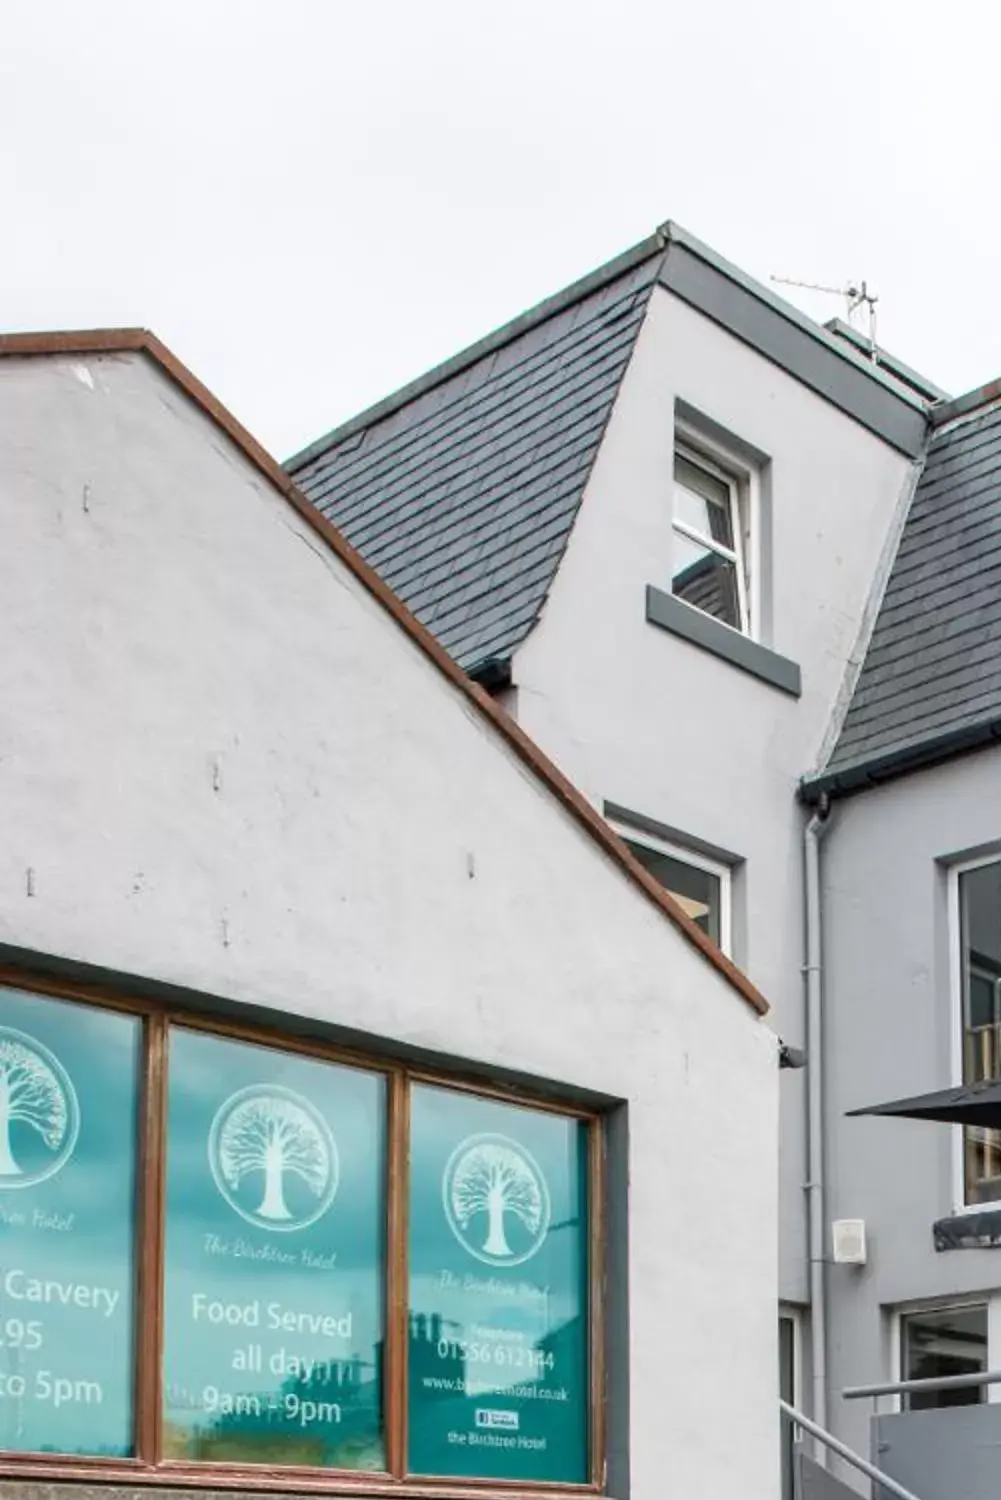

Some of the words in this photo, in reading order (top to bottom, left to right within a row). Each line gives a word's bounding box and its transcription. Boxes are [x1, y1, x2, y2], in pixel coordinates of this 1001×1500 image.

[5, 1269, 119, 1317] Carvery
[192, 1293, 260, 1327] Food
[267, 1302, 353, 1338] Served
[231, 1344, 262, 1373] all
[269, 1348, 314, 1383] day
[35, 1369, 103, 1409] 5pm
[202, 1385, 261, 1417] 9am
[284, 1393, 342, 1427] 9pm
